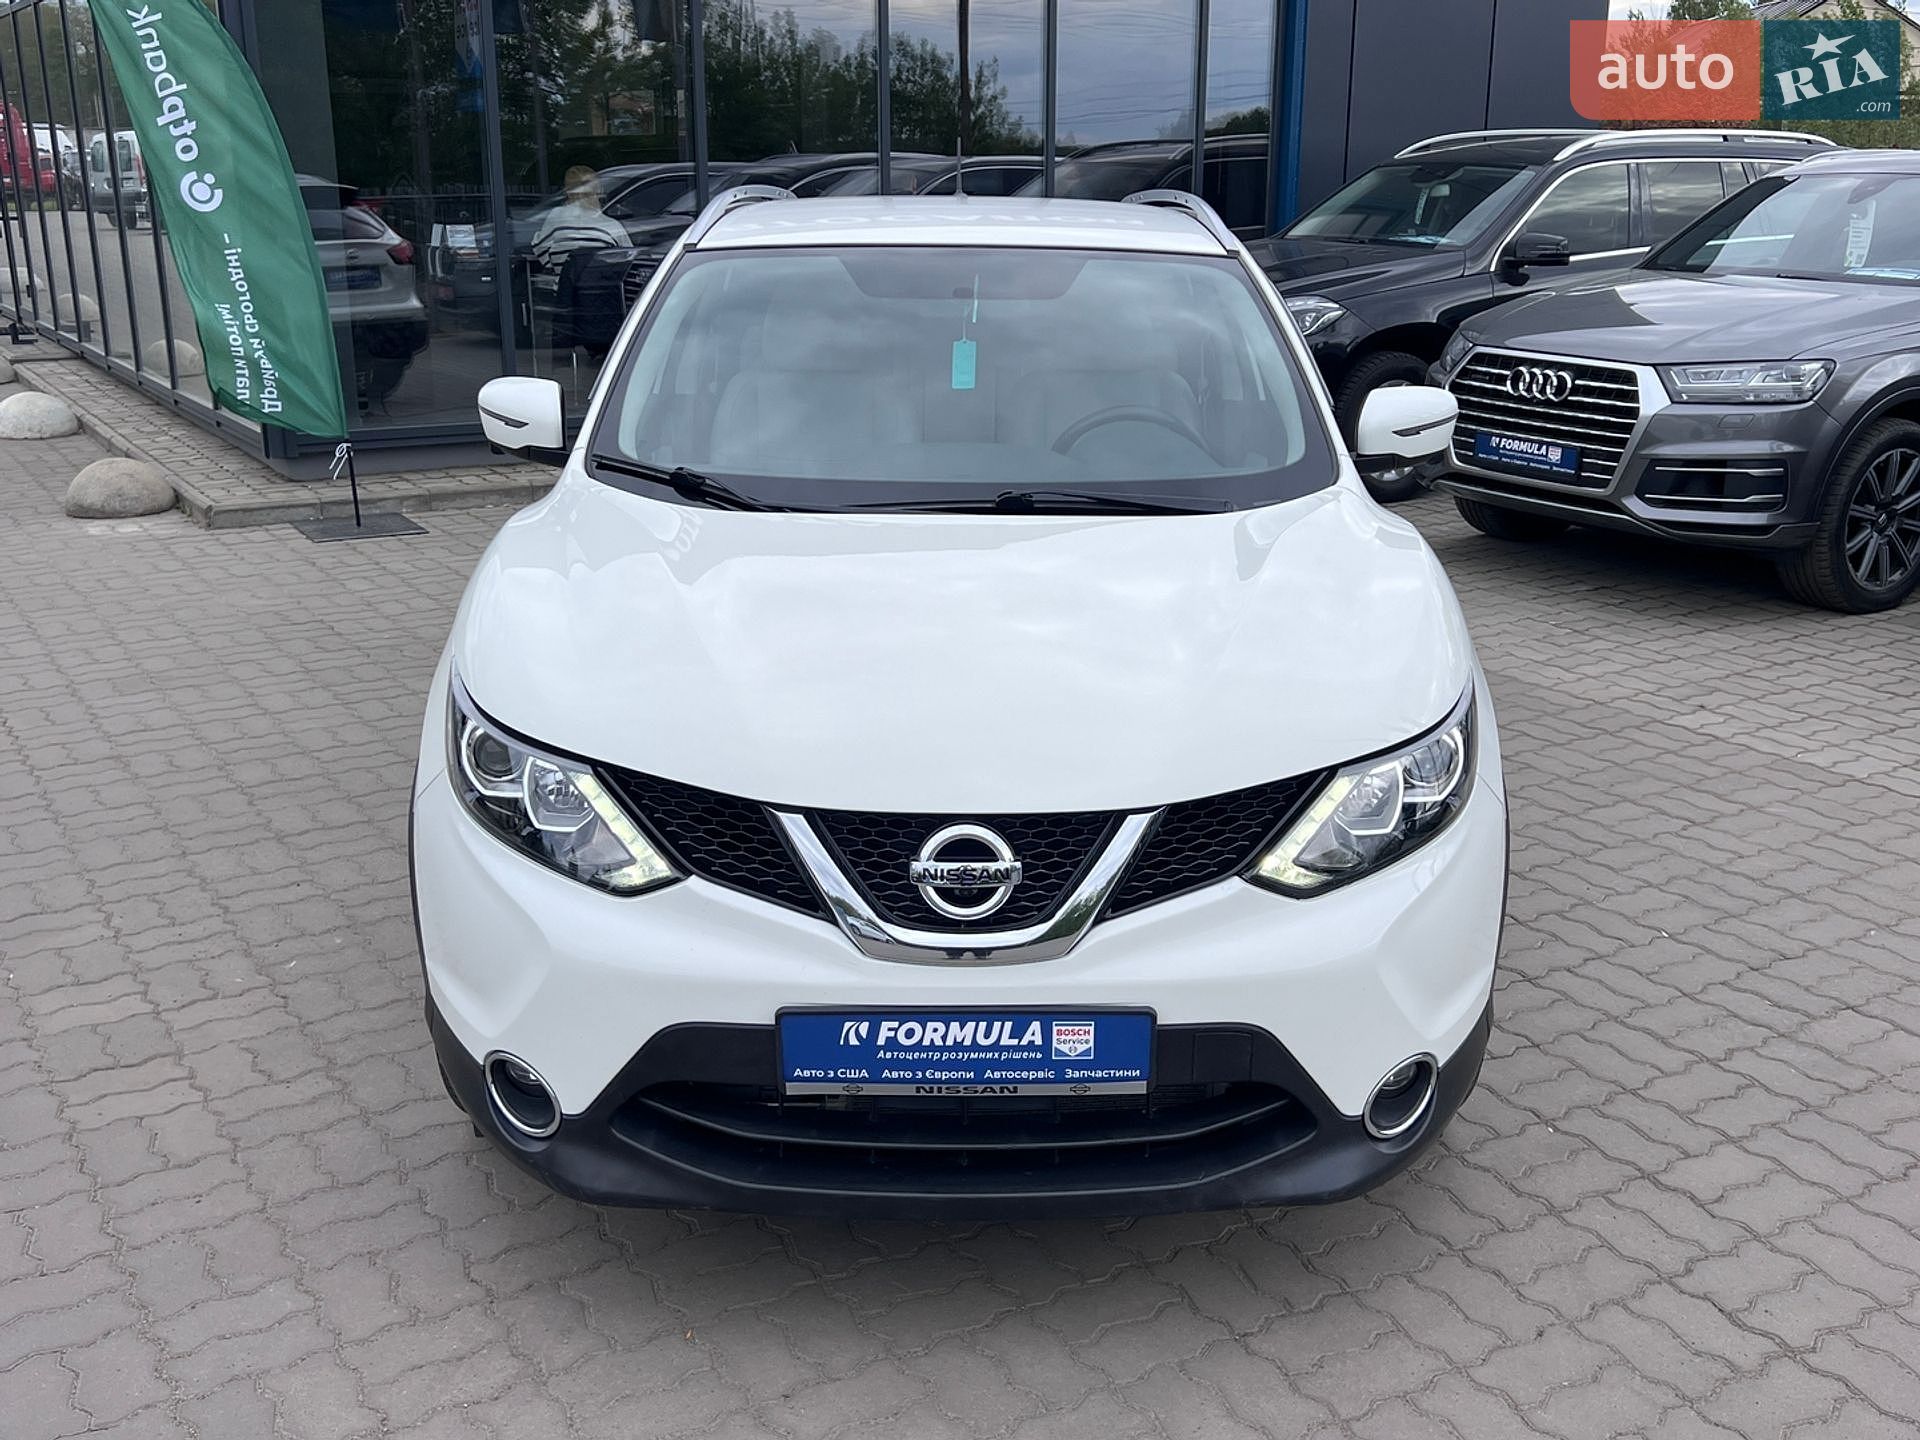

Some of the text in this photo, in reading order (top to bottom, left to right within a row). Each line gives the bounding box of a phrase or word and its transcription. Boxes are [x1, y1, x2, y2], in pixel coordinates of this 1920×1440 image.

[1500, 437, 1547, 456] FORMULA
[921, 866, 1010, 881] NISSAN
[876, 1021, 1043, 1046] FORMULA
[1056, 1028, 1091, 1037] BOSCH
[1056, 1037, 1090, 1045] Service
[876, 1050, 1043, 1061] Автоцентр розумних рішень
[793, 1068, 1140, 1080] Авто з США Авто з Європи Автосервіс Запчастини
[915, 1085, 1018, 1094] NISSAN
